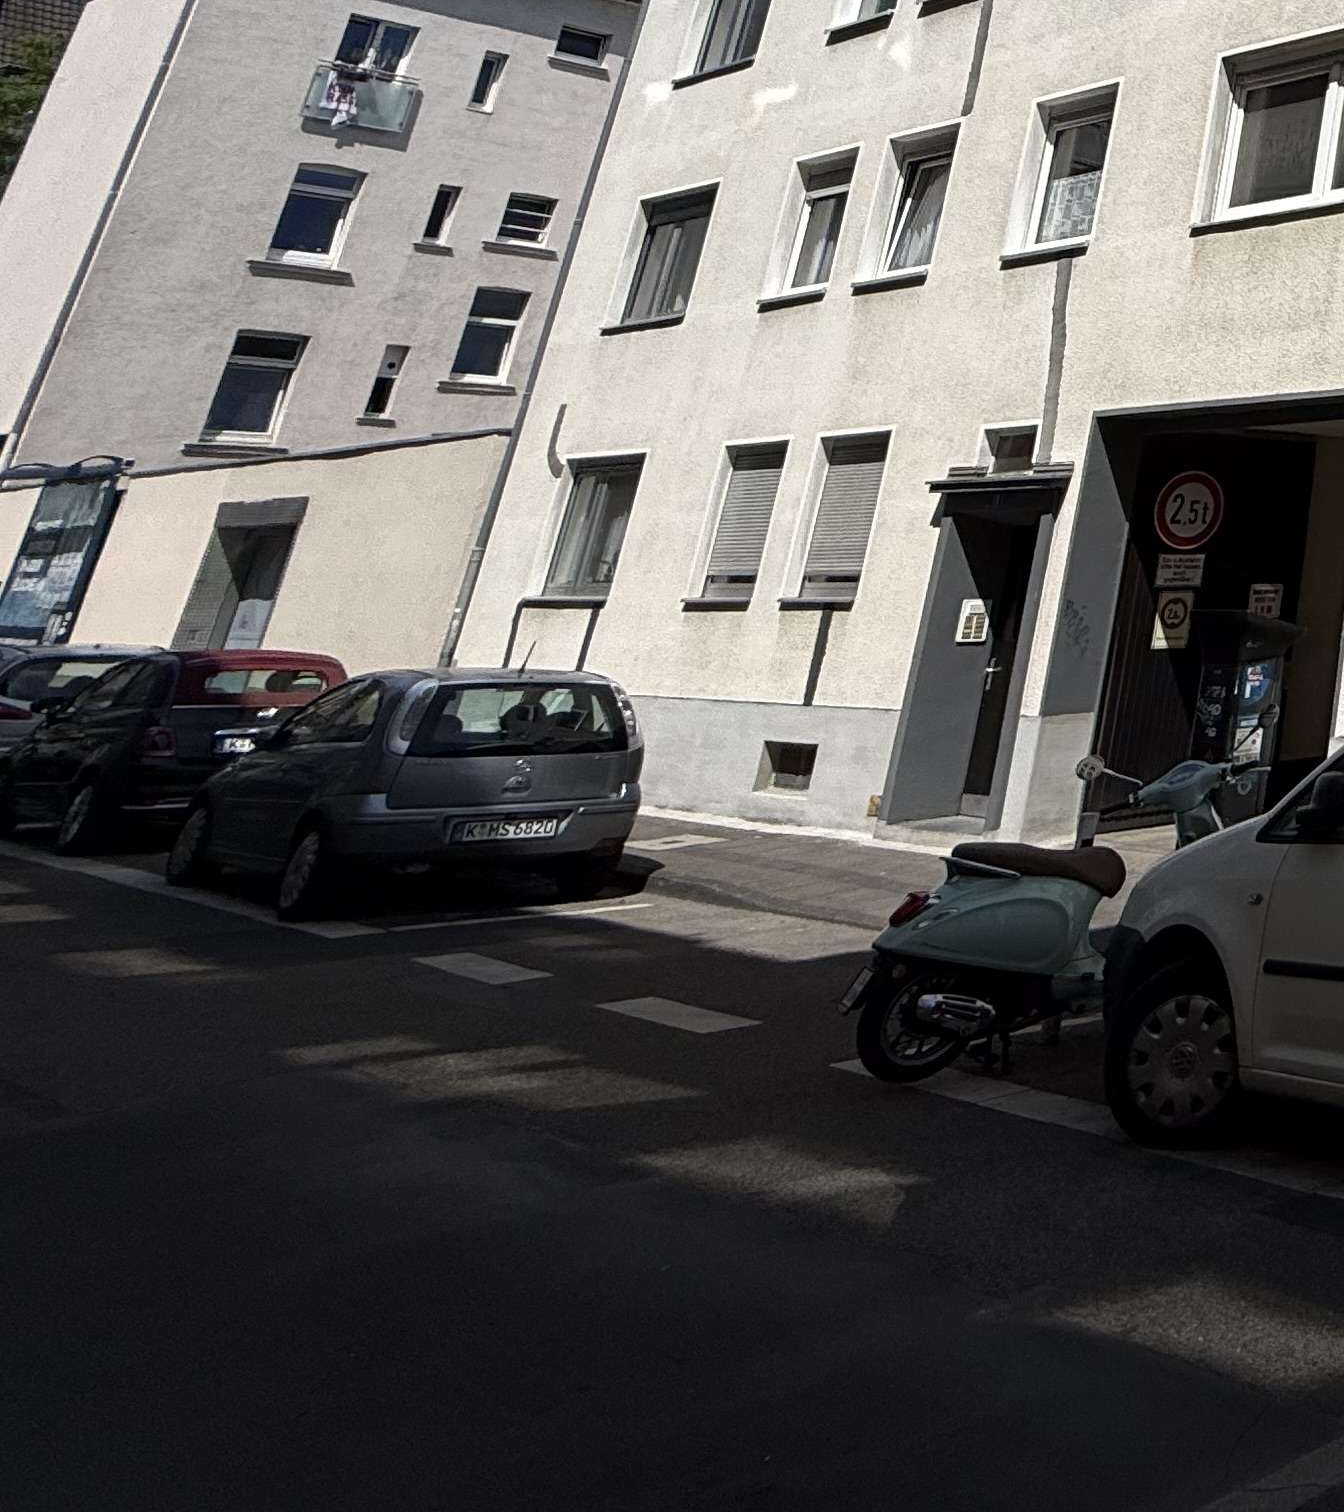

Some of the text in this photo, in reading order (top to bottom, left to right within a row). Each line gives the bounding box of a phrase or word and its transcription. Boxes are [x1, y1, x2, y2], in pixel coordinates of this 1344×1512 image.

[465, 818, 554, 838] K MS 6820
